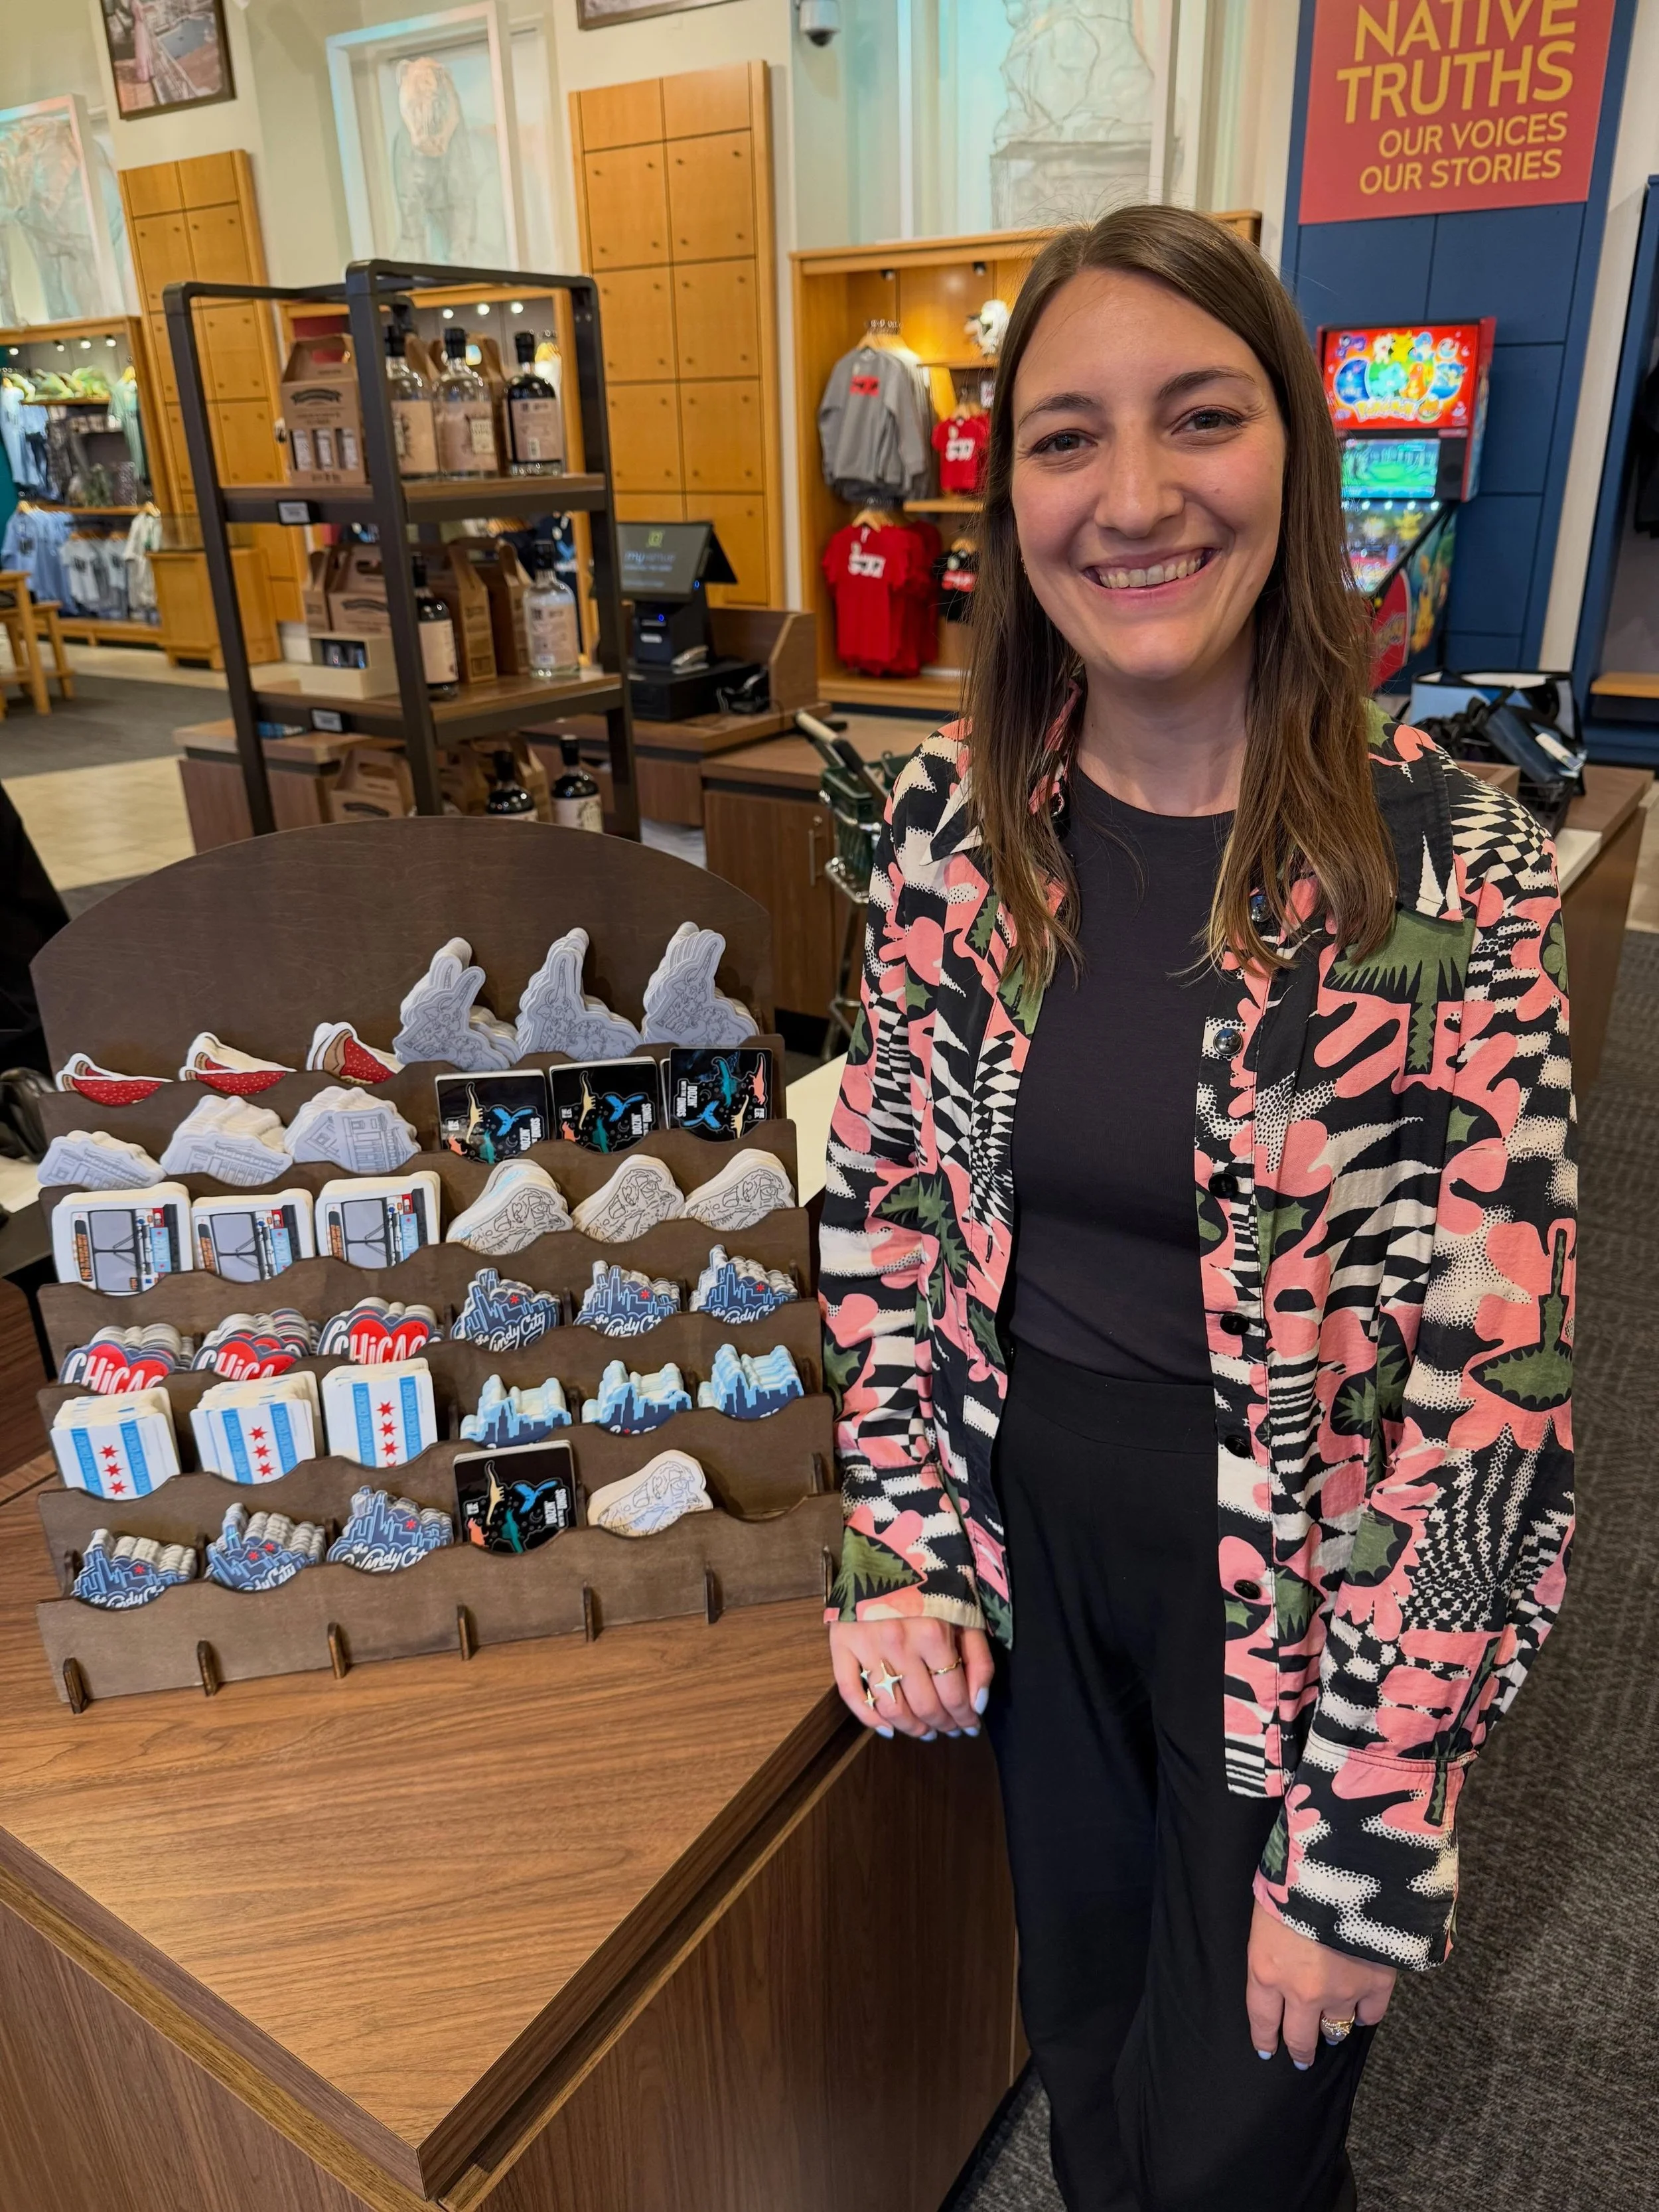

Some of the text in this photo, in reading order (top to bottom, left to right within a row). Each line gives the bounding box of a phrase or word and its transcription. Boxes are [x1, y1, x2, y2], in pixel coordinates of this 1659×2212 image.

[1354, 0, 1578, 61] NATIVE
[1336, 40, 1576, 124] TRUTHS
[1379, 111, 1569, 159] OUR VOICES
[1359, 148, 1563, 195] OUR STORIES
[520, 1311, 545, 1336] City
